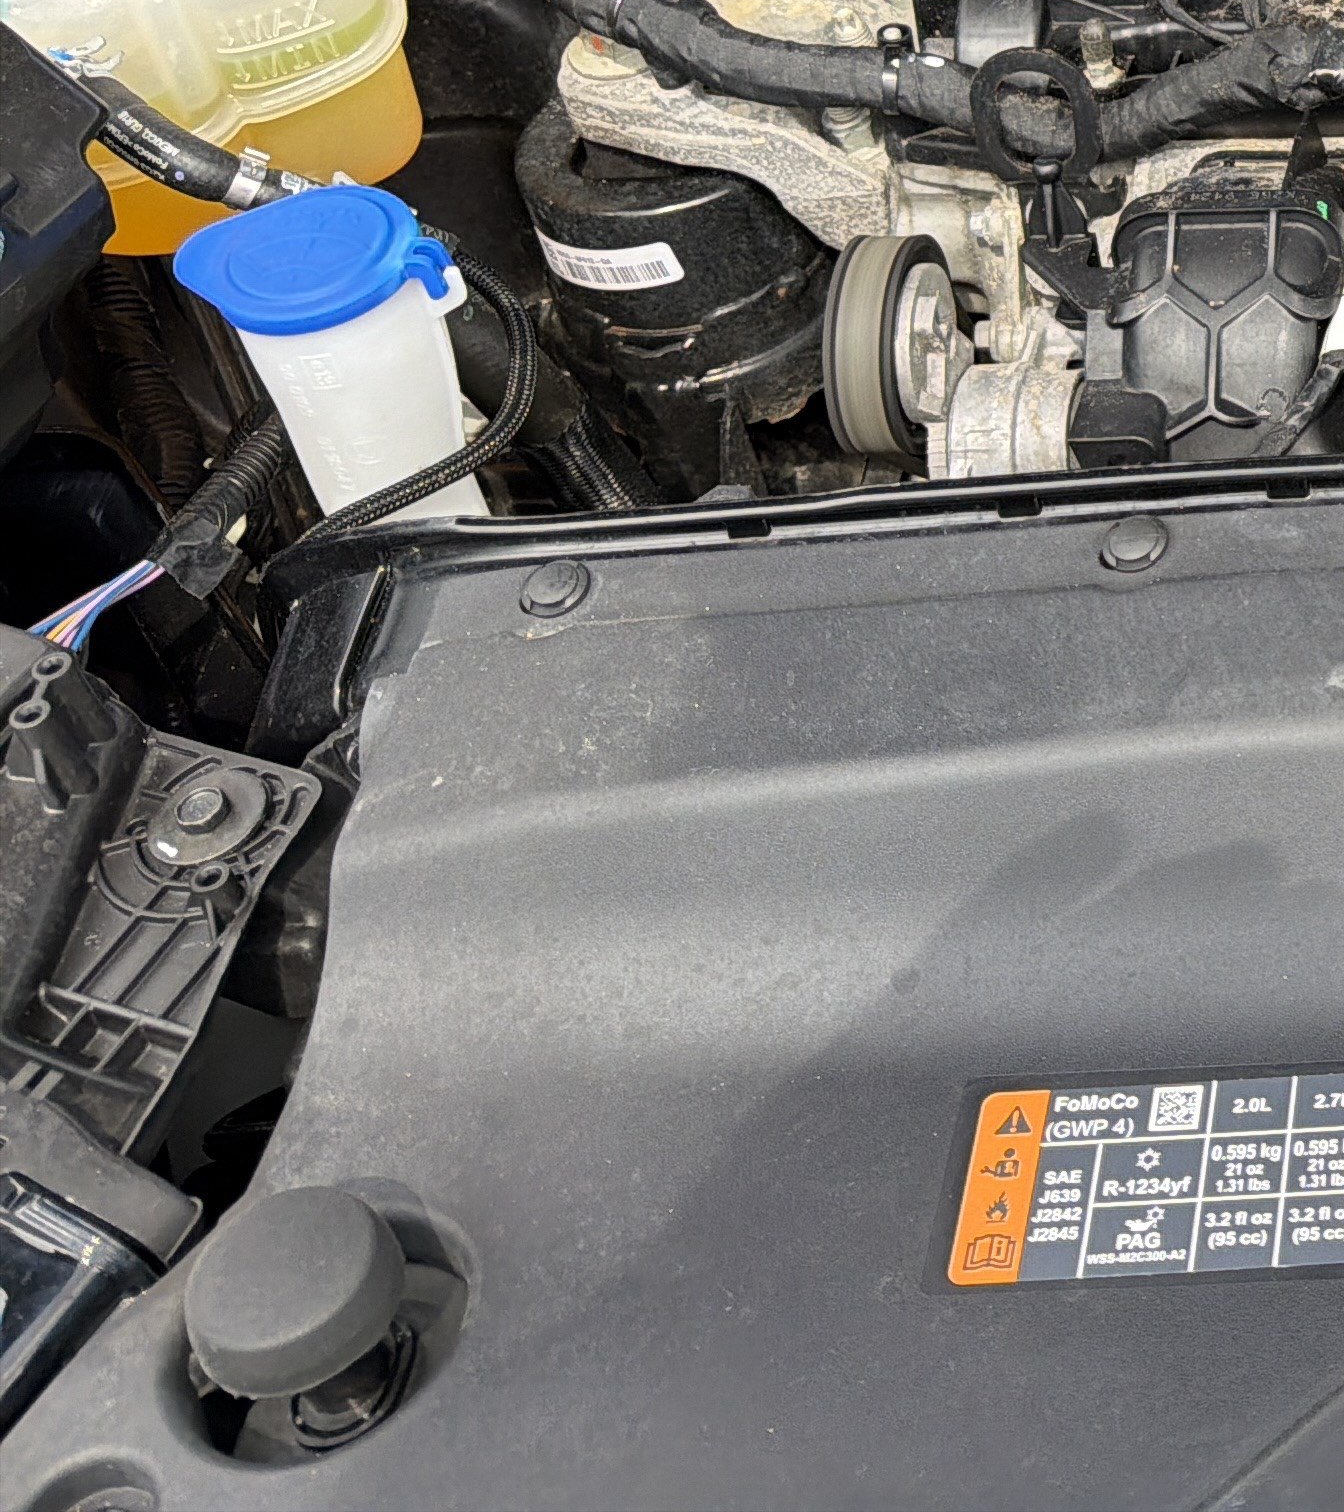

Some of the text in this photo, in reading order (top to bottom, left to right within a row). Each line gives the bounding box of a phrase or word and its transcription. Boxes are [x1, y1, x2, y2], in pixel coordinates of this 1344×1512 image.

[251, 33, 340, 80] MIN
[1054, 1093, 1139, 1112] FoMoCo
[1232, 1098, 1272, 1114] 2.0L
[1045, 1118, 1134, 1142] (GWP 4)
[1211, 1142, 1282, 1162] 0.595 kg
[1293, 1139, 1339, 1156] 0.595
[1224, 1163, 1264, 1176] 21 oz
[1307, 1158, 1325, 1172] 21
[1043, 1170, 1082, 1185] SAE
[1215, 1178, 1270, 1193] 1.31 lbs
[1299, 1174, 1327, 1188] 1.31
[1102, 1176, 1192, 1197] R-1234yf
[1037, 1188, 1081, 1204] J639
[1031, 1207, 1082, 1223] J2842
[1204, 1211, 1273, 1227] 3.2 fl oz
[1287, 1207, 1315, 1223] 3.2
[1318, 1206, 1331, 1221] fl
[1027, 1226, 1079, 1242] J2845
[1115, 1232, 1161, 1250] PAG
[1207, 1229, 1268, 1250] (95 cc)
[1291, 1226, 1320, 1245] (95
